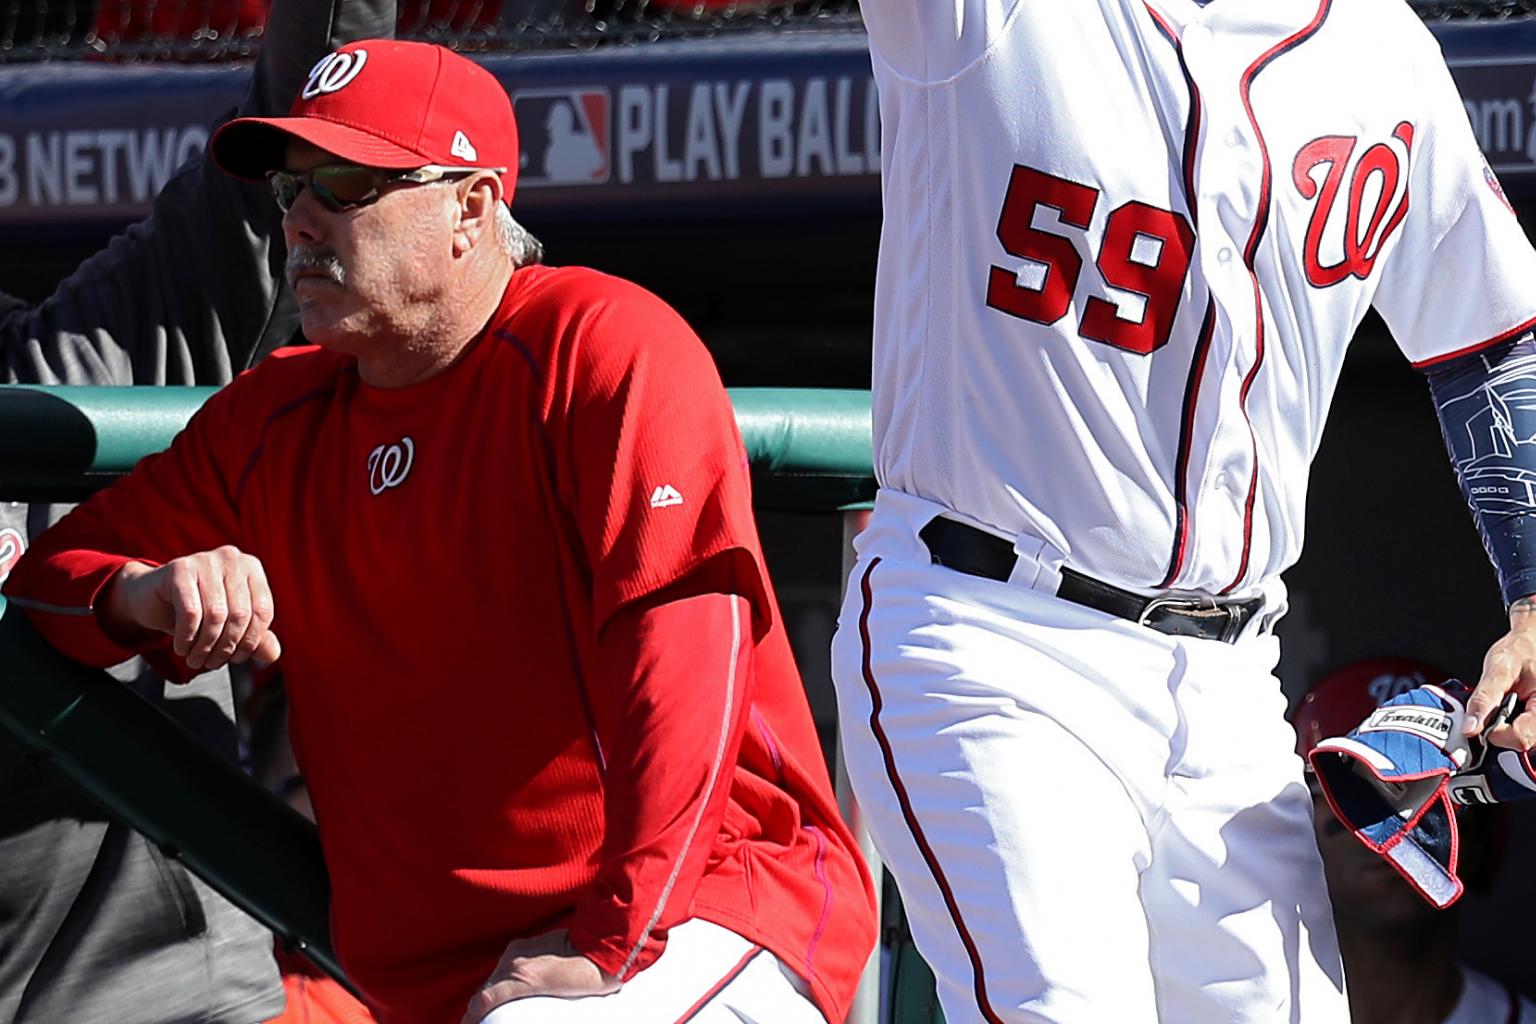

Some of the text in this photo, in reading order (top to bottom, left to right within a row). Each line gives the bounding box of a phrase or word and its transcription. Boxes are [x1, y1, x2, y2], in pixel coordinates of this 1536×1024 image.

[618, 79, 751, 185] PLAY
[985, 163, 1197, 357] 59
[1292, 120, 1415, 289] W
[367, 436, 415, 496] W
